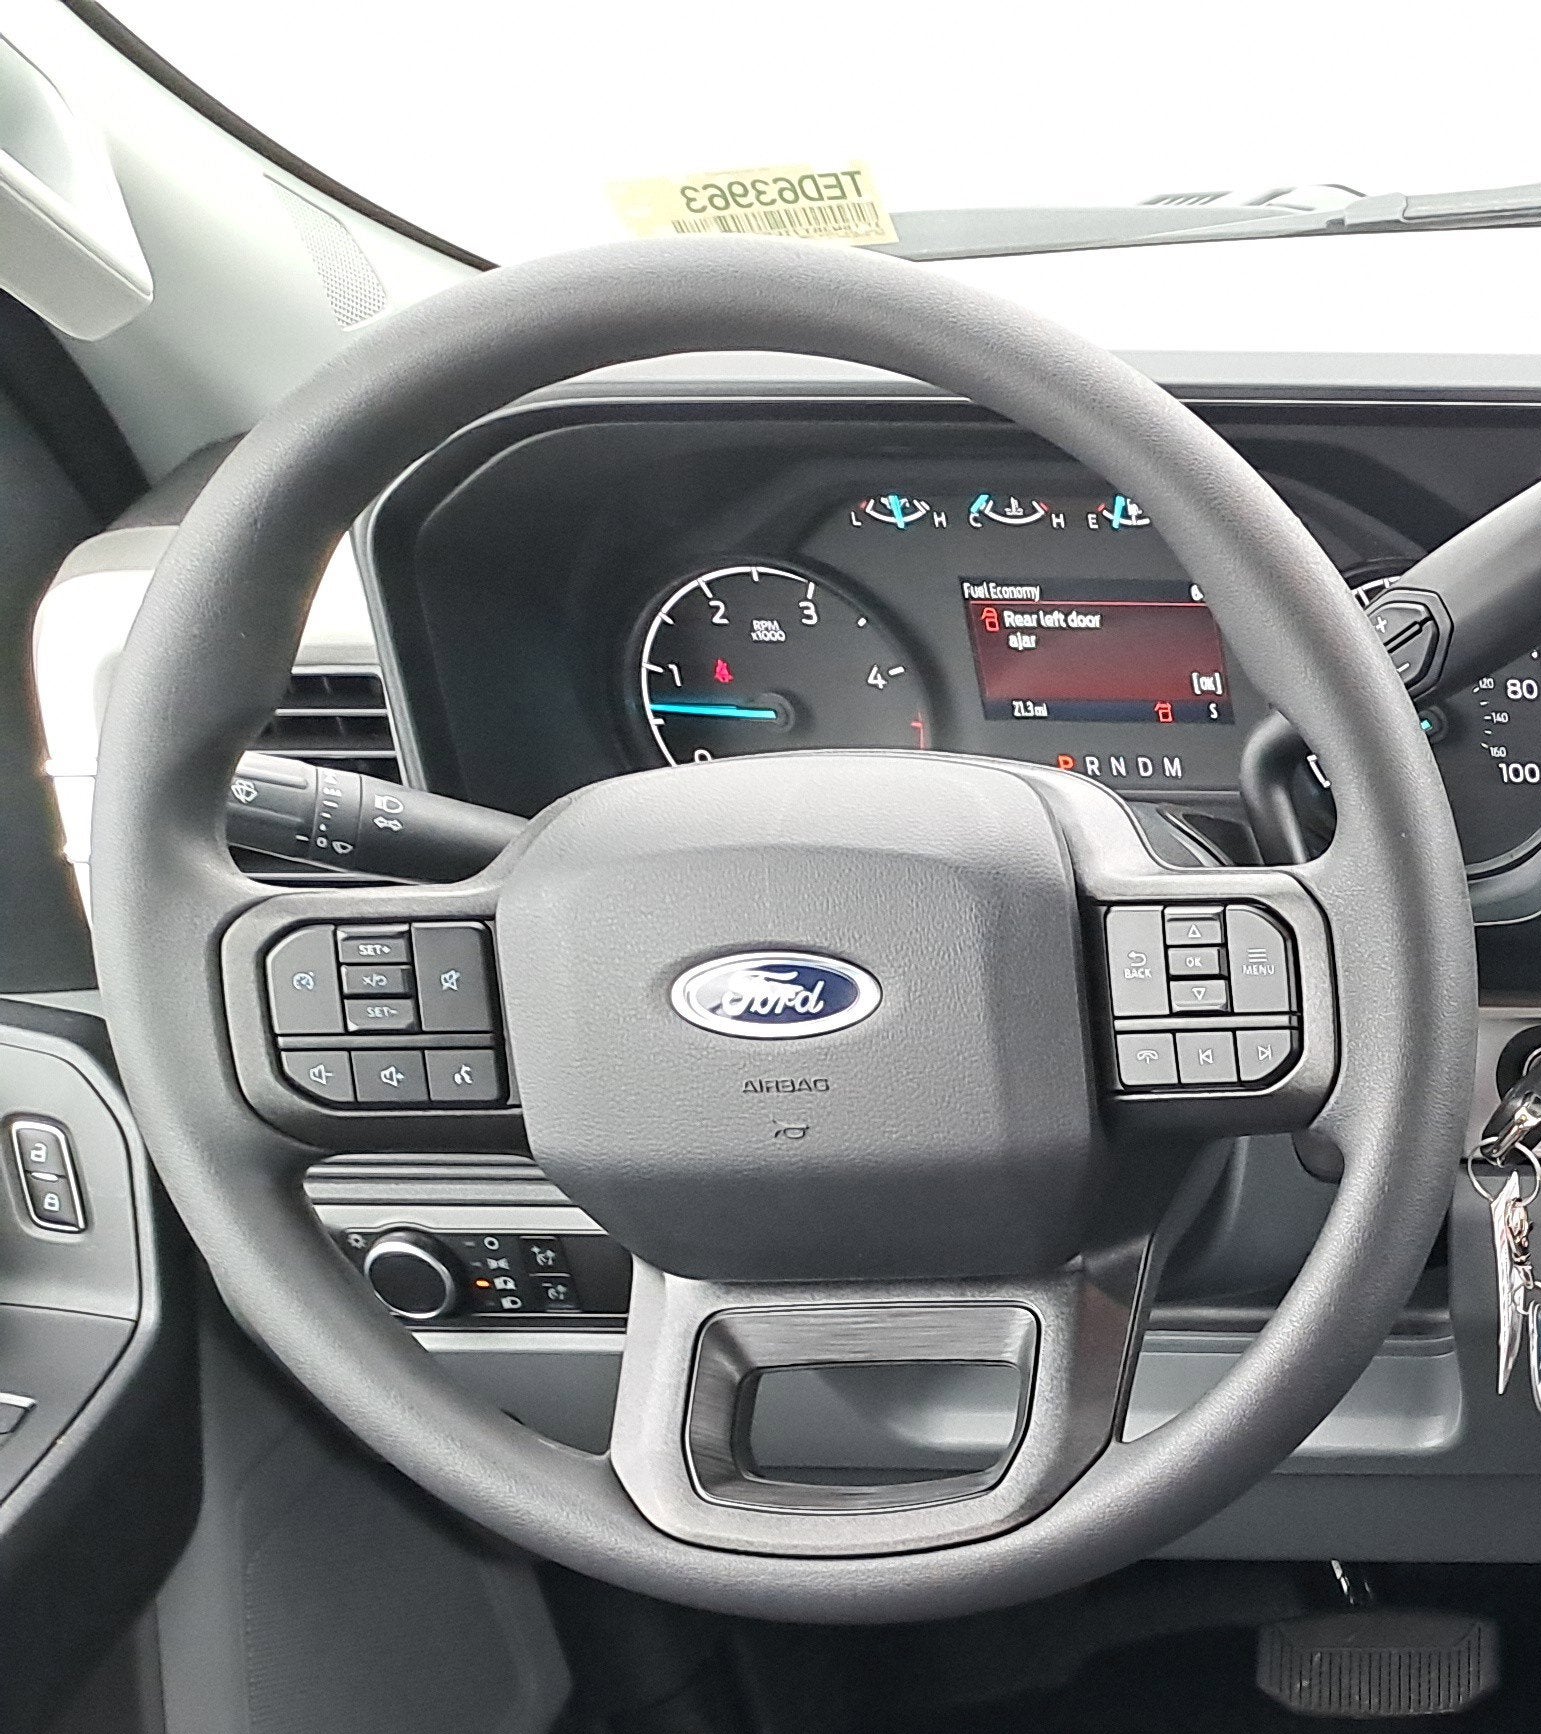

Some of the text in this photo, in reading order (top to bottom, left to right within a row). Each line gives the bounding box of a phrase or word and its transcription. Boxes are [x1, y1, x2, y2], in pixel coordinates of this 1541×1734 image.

[962, 581, 1041, 603] Fuel Economy
[709, 600, 730, 625] 2
[798, 601, 818, 626] 3
[1003, 610, 1101, 628] Rear left door
[752, 619, 780, 631] RPM
[1008, 631, 1036, 651] ajar
[668, 663, 682, 687] 1
[867, 664, 887, 689] 4
[1506, 679, 1539, 700] 80
[1084, 756, 1101, 776] R
[1110, 756, 1127, 776] N
[1137, 757, 1153, 776] D
[1163, 757, 1182, 778] M
[1498, 763, 1540, 783] 100
[1123, 967, 1152, 979] BACK
[1186, 957, 1203, 968] OK
[1242, 964, 1275, 975] MENU
[720, 969, 826, 1016] Ford
